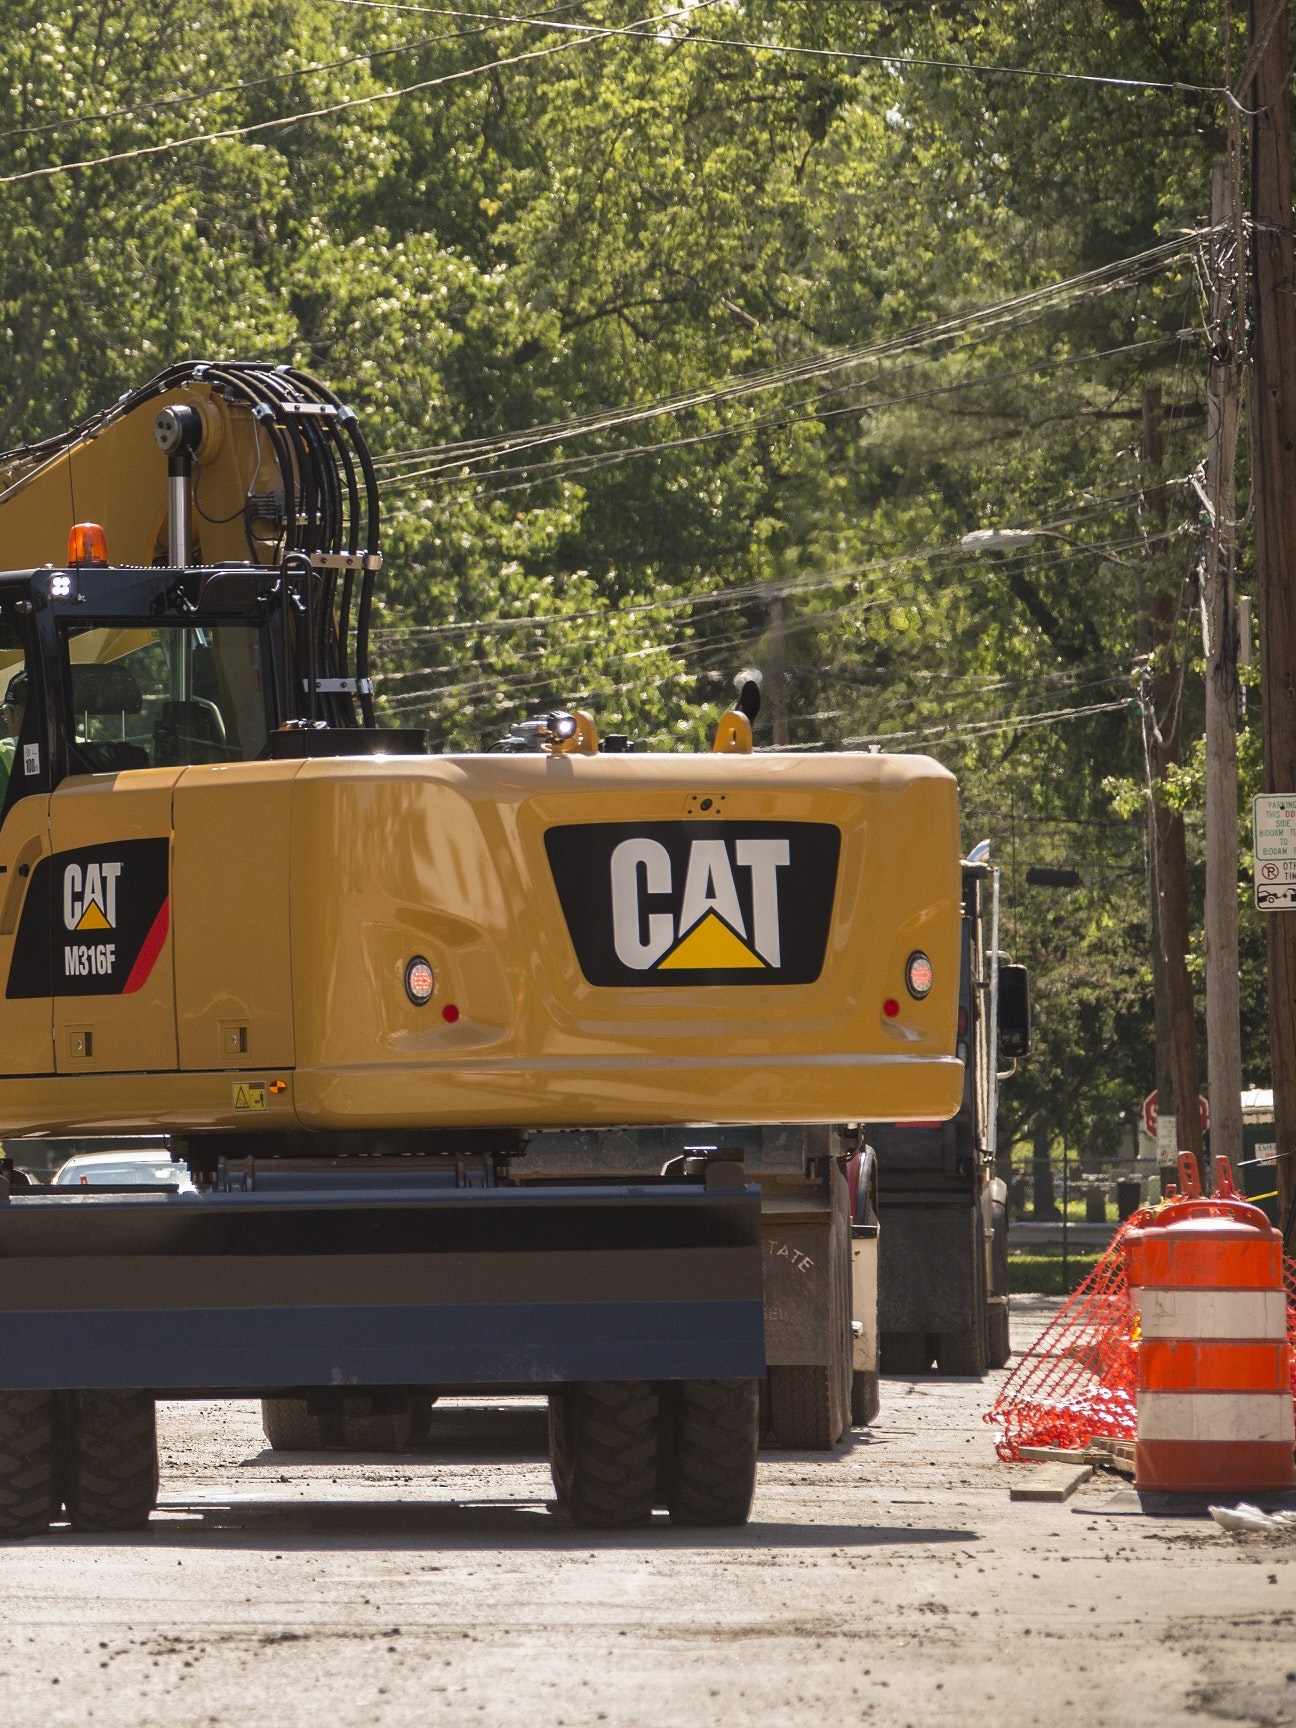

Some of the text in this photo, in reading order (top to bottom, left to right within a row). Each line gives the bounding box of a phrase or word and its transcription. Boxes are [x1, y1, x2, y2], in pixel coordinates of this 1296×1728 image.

[1266, 810, 1281, 818] THIS
[1275, 819, 1291, 828] SIDE
[1280, 838, 1288, 846] TO
[64, 862, 122, 931] CAT
[610, 837, 791, 970] CAT
[65, 944, 116, 976] M316F
